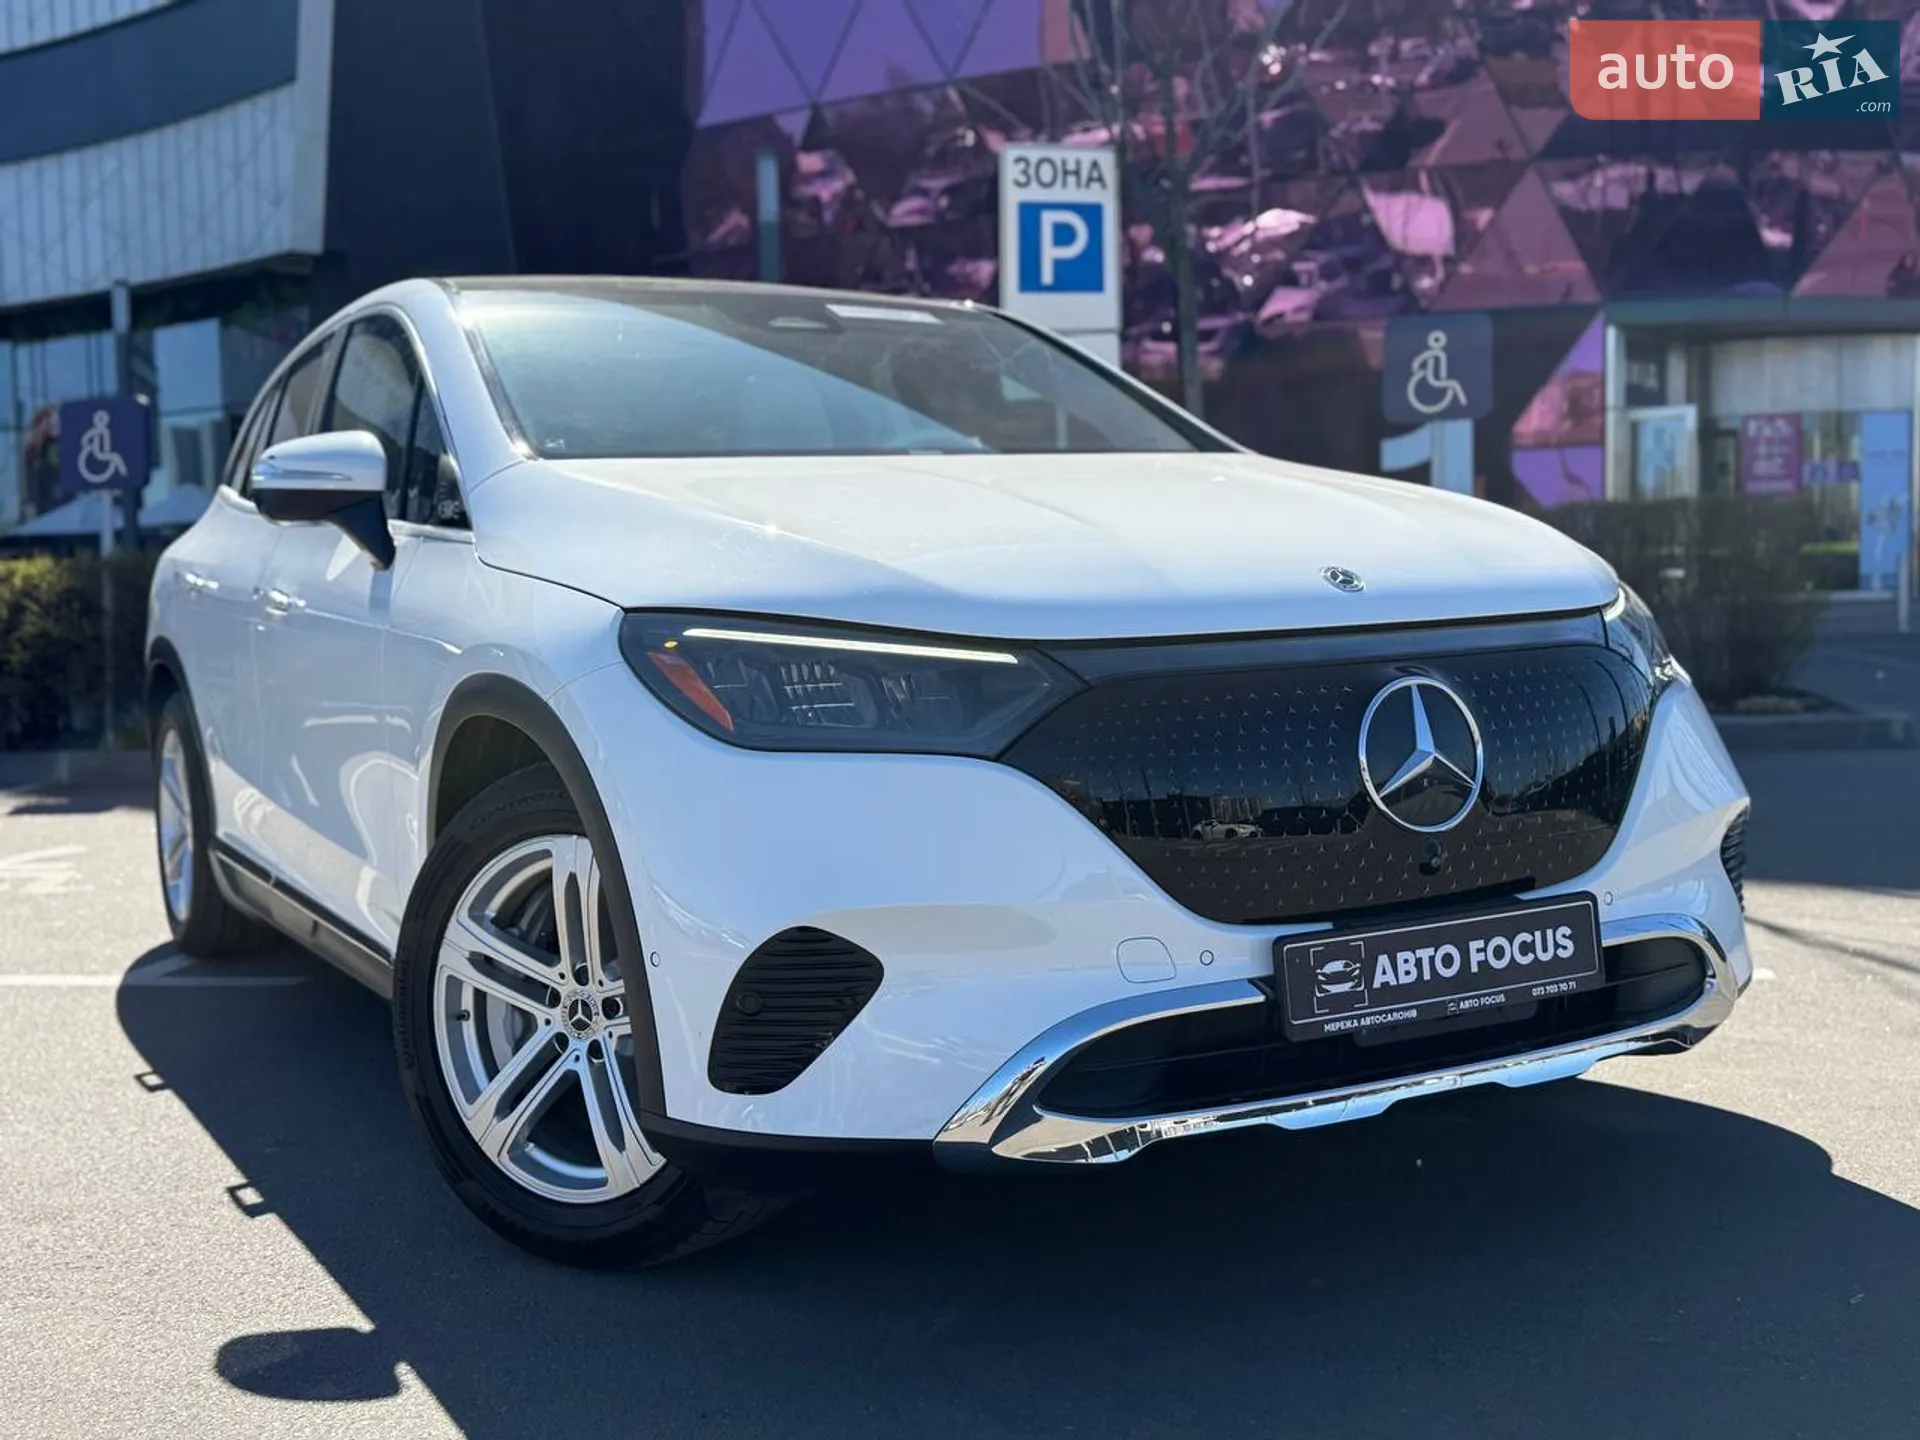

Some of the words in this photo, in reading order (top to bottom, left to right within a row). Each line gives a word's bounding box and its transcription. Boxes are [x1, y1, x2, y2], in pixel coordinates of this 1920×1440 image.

[1013, 156, 1107, 189] ЗОНА
[1040, 209, 1089, 286] P
[1372, 943, 1461, 989] АВТО
[1468, 925, 1574, 973] FOCUS
[1459, 998, 1479, 1010] АВТО
[1480, 993, 1506, 1006] FOCUS
[1324, 1018, 1359, 1033] МЕРЕЖА
[1360, 1008, 1418, 1026] АВТОСАЛОНІВ
